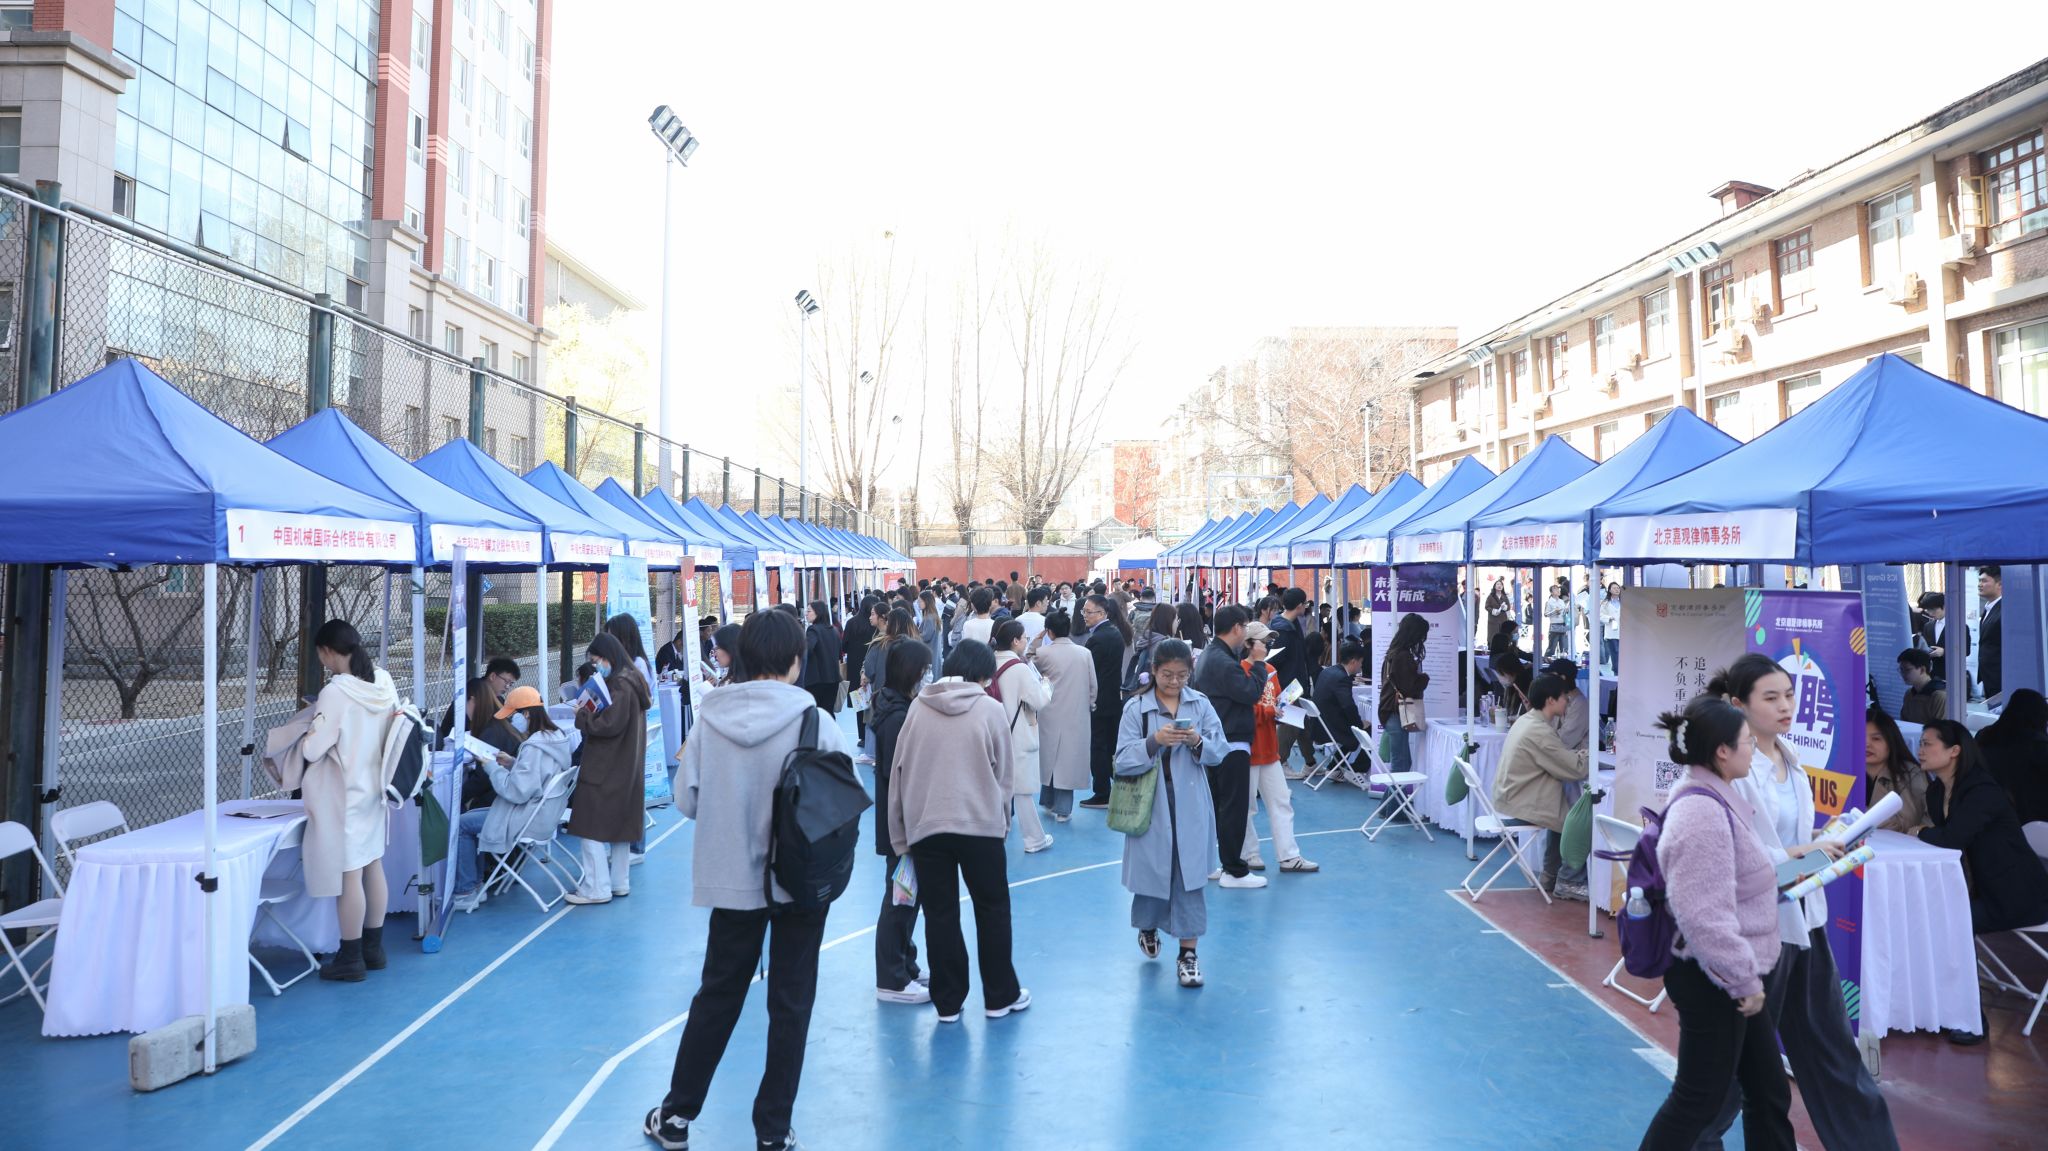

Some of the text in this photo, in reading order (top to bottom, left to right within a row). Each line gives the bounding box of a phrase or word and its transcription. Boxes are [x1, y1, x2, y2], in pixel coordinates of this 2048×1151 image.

[238, 525, 397, 550] 1 中国机械国际合作股份有限公司
[1604, 525, 1741, 546] 38 北京嘉观律师事务所
[1793, 734, 1827, 751] HIRING!
[1820, 778, 1838, 808] US
